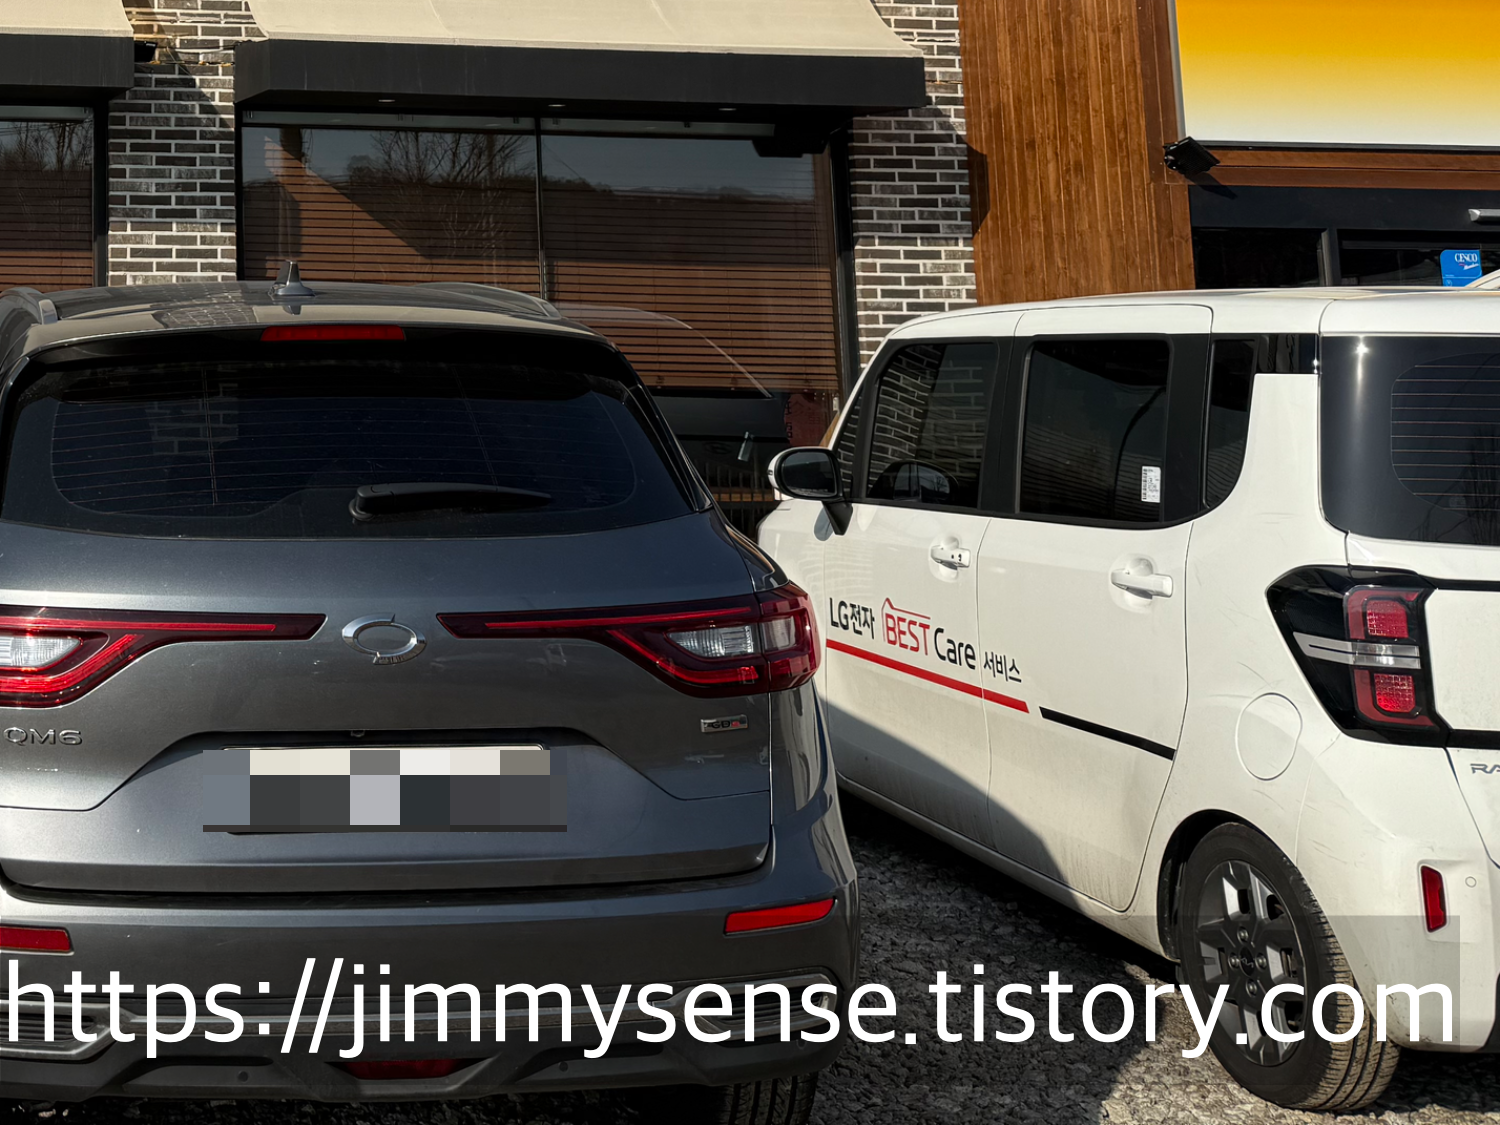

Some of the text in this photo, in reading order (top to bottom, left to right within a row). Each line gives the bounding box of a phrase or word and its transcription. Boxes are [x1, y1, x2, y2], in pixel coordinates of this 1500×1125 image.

[829, 598, 1022, 683] LG전자 BEST Care 서비스
[3, 726, 83, 746] QM6
